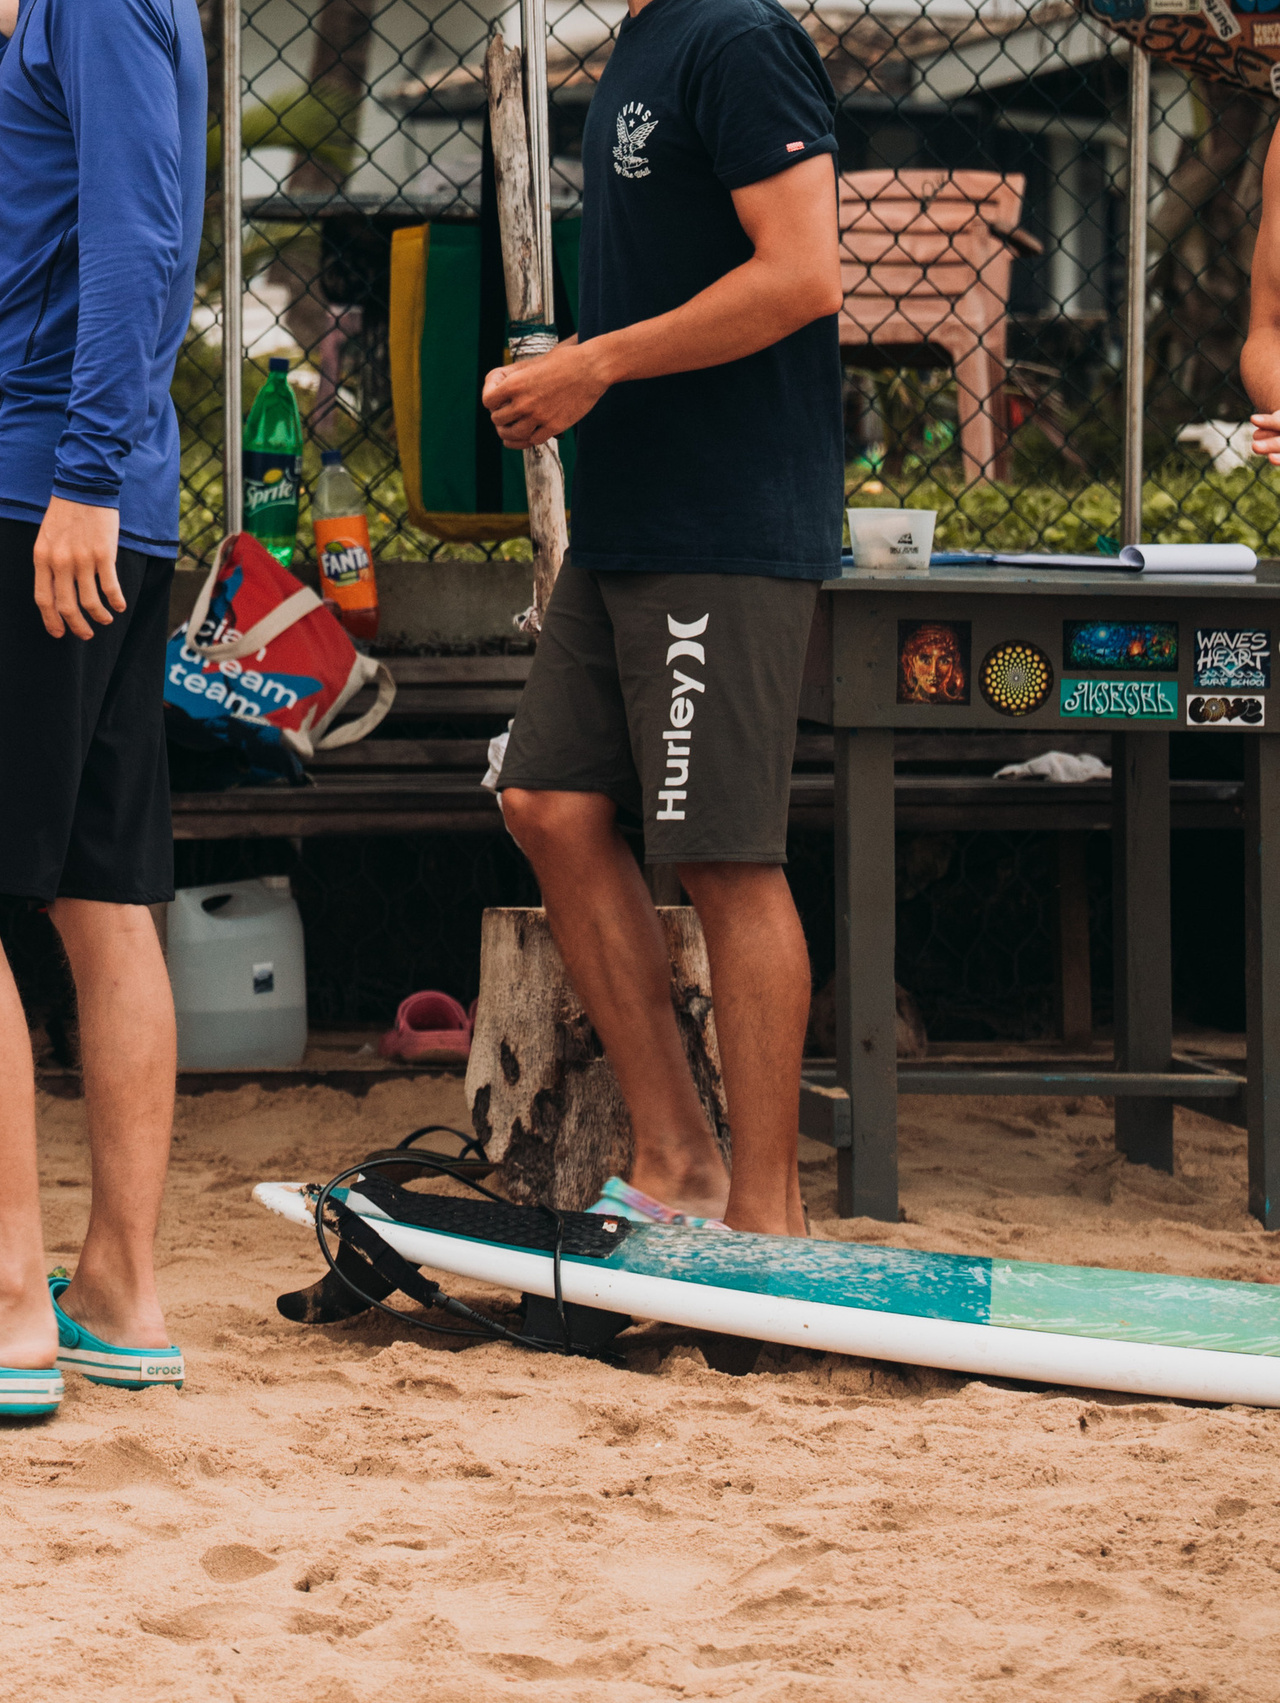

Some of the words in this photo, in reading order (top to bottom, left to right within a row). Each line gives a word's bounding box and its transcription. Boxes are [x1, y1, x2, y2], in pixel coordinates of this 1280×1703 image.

[623, 101, 652, 122] VANS
[247, 478, 294, 510] Sprite
[1197, 630, 1267, 651] WAVES
[1197, 648, 1271, 672] HEART
[168, 663, 261, 717] team
[1200, 677, 1228, 687] SURF
[656, 669, 706, 821] Hurley
[147, 1366, 182, 1375] crocs
